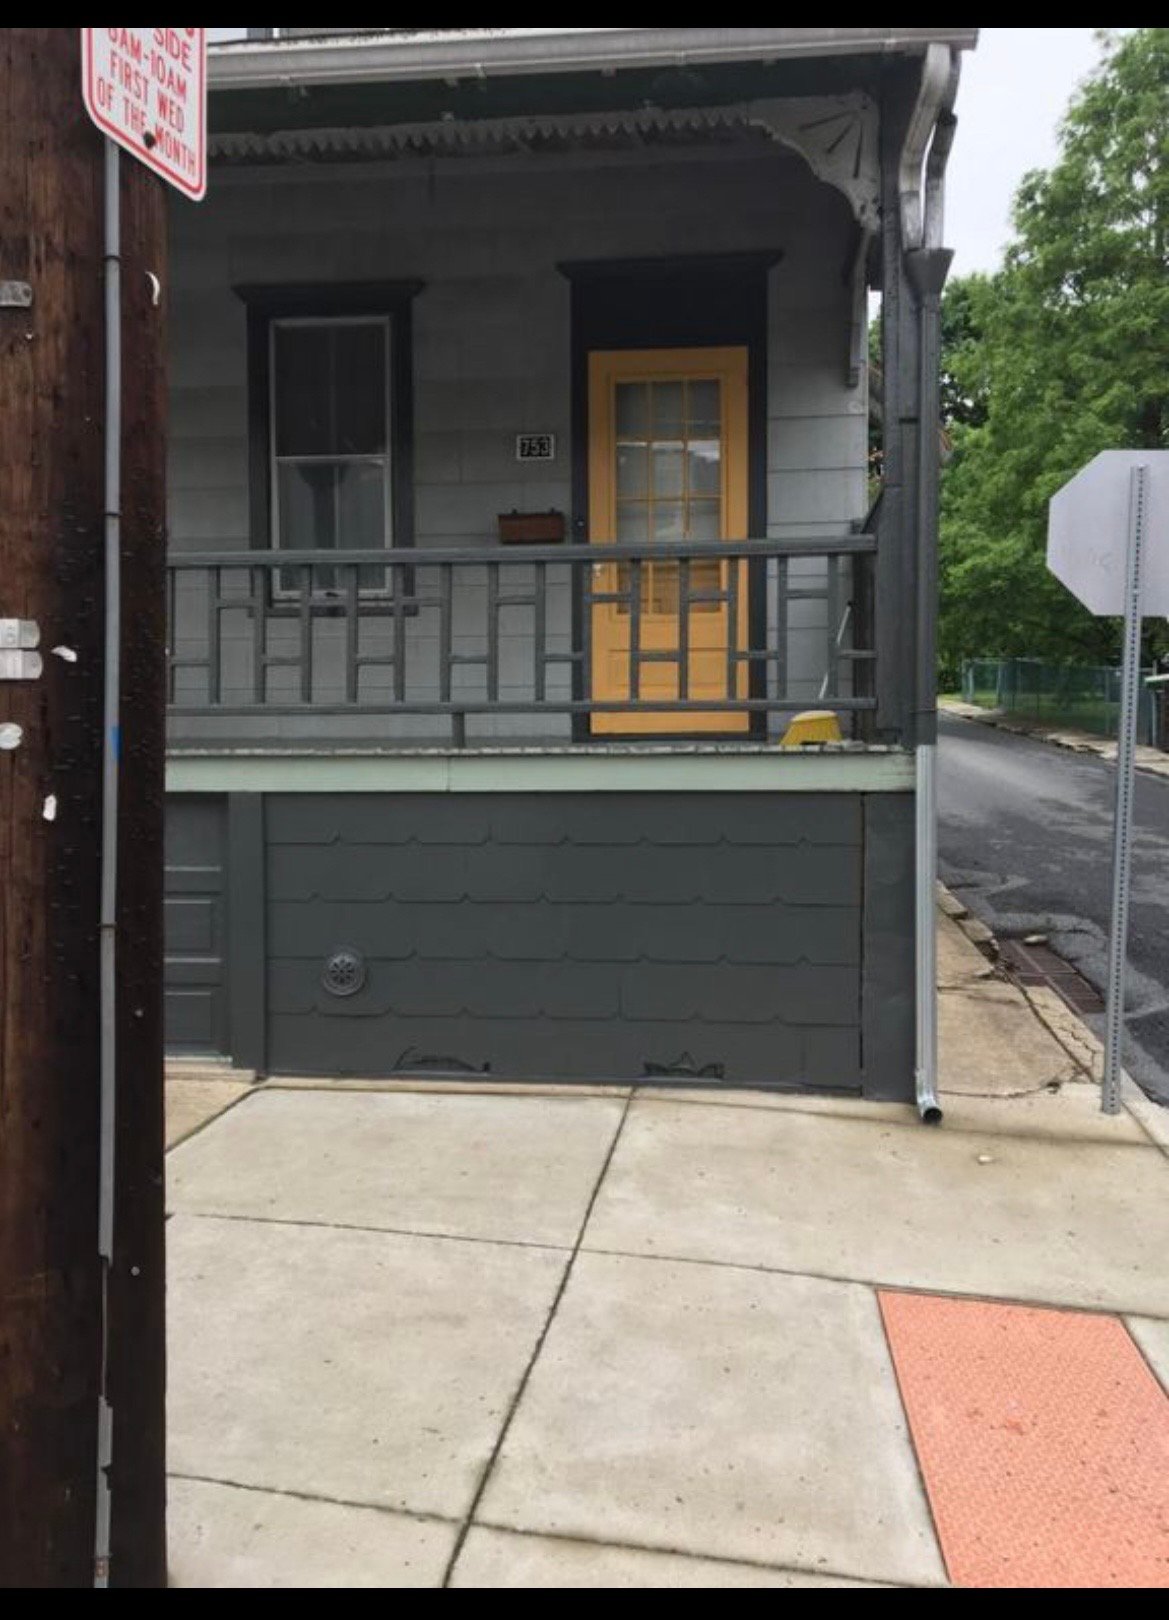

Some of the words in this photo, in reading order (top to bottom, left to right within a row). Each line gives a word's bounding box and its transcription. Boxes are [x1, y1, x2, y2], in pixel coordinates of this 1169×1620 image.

[153, 28, 192, 73] SIDE
[110, 49, 149, 105] FIRST
[157, 88, 185, 133] WED
[97, 77, 114, 111] OF
[123, 97, 147, 136] THE
[155, 123, 196, 176] MONTH
[521, 438, 549, 456] 753
